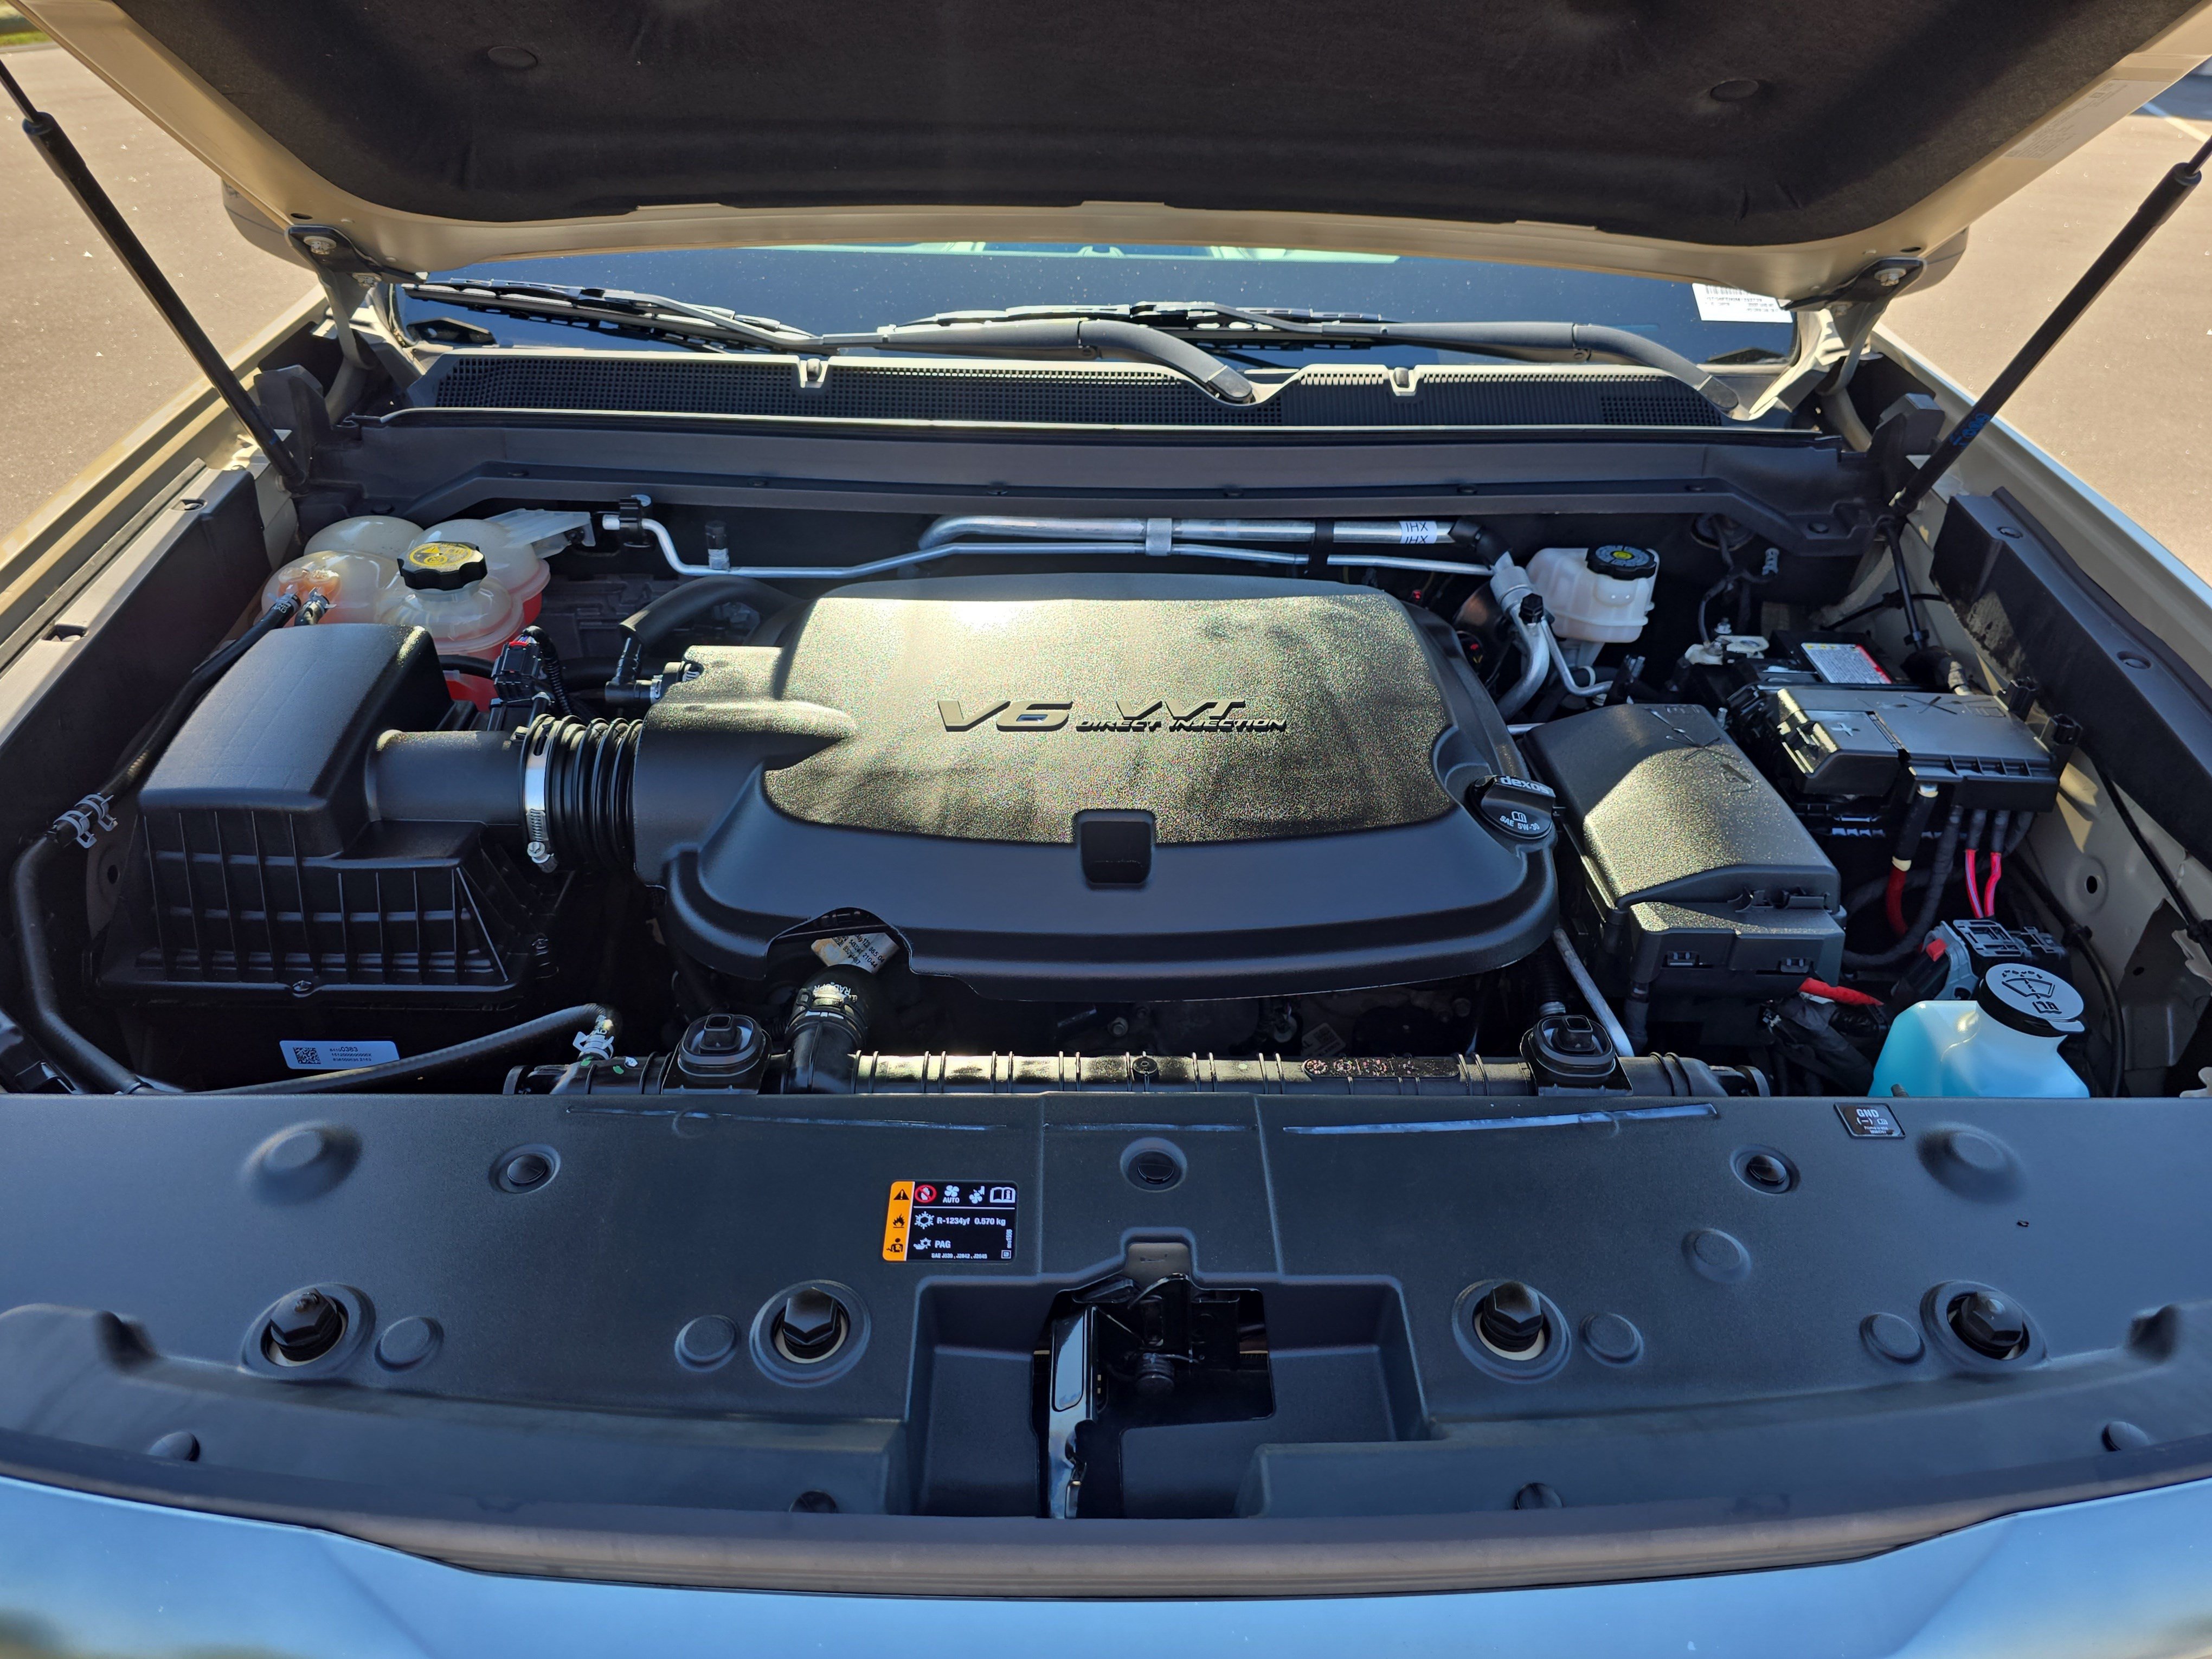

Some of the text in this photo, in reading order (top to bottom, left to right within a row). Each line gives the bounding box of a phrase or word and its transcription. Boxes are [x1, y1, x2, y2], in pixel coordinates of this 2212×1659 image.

[1406, 522, 1428, 532] IHX
[938, 700, 1246, 732] V6 VVT
[1076, 718, 1287, 732] DIRECT INJECTION
[1500, 776, 1549, 794] dexos
[1500, 815, 1540, 831] SAE 5W-30
[1856, 1109, 1879, 1117] GND
[937, 1217, 970, 1225] R-1234yf
[996, 1218, 1006, 1226] kg
[935, 1240, 951, 1248] PAG
